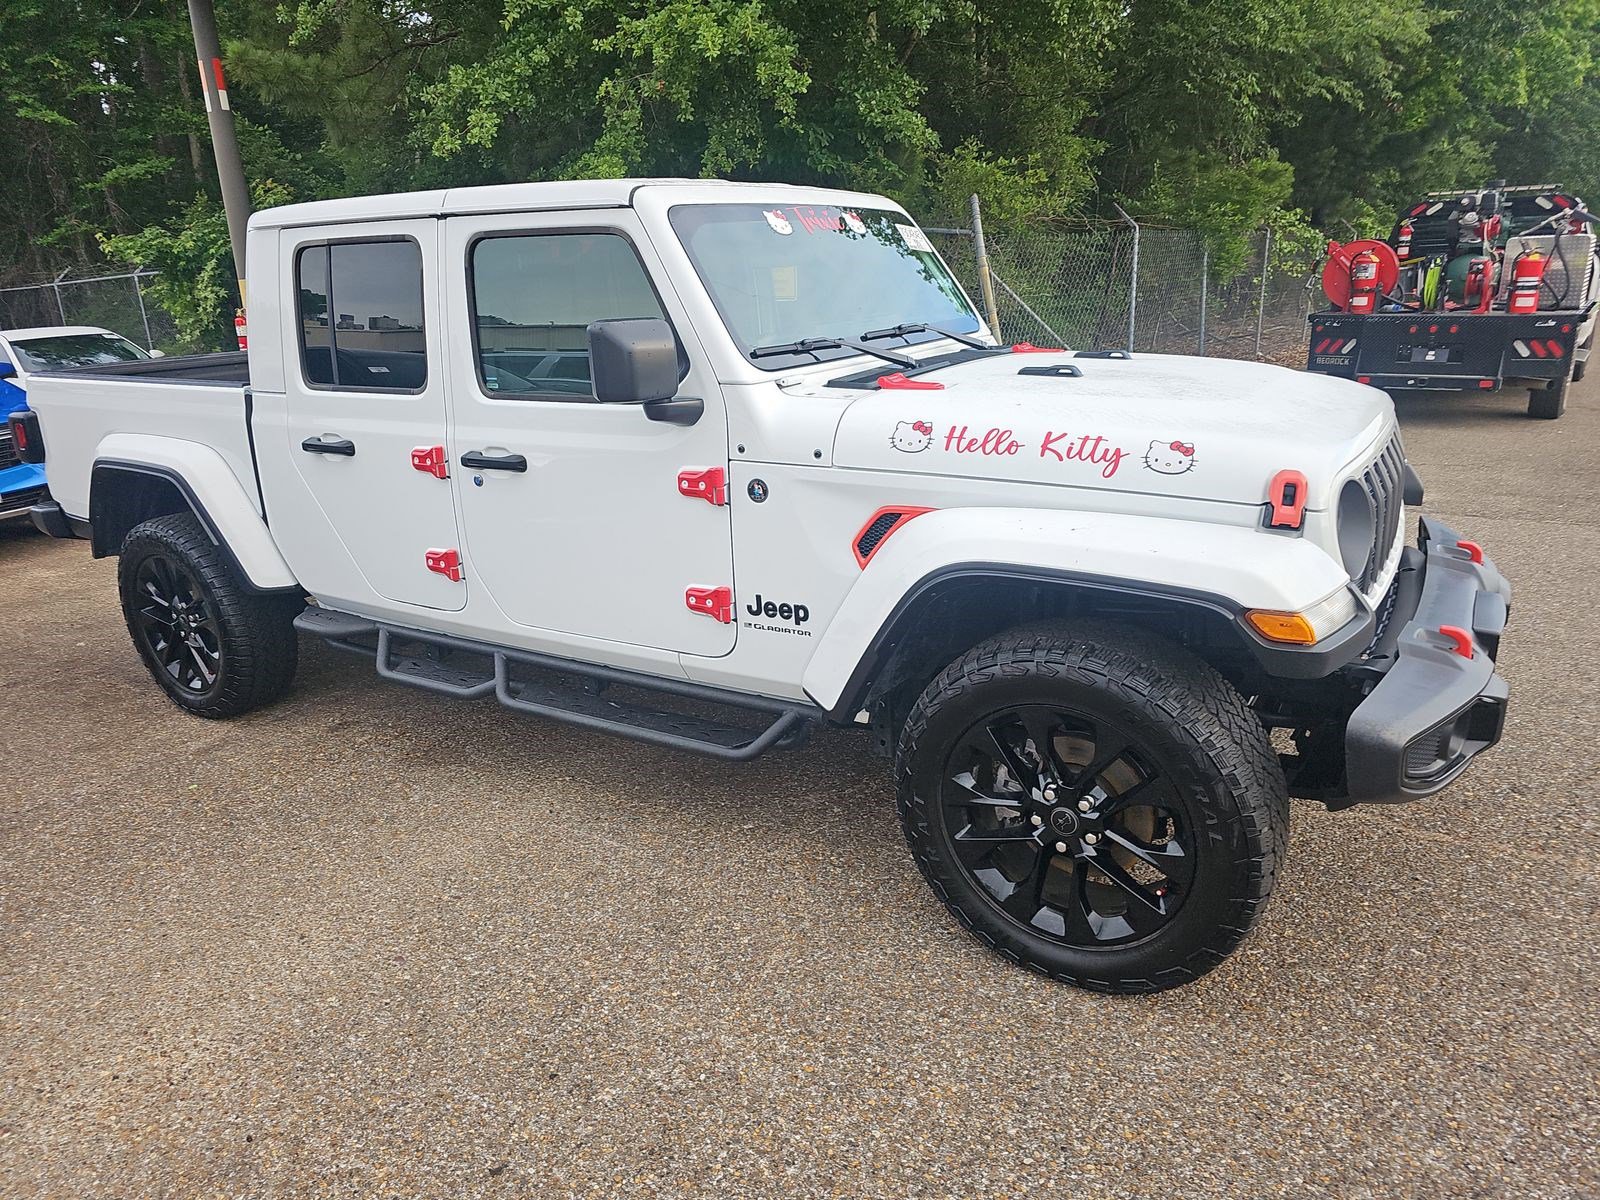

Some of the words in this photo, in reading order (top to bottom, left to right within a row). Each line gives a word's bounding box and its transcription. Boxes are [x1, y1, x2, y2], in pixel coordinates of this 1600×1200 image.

[944, 425, 1026, 456] Hello
[1040, 431, 1131, 479] Kitty
[746, 594, 810, 626] Jeep
[753, 623, 813, 637] GLADIATOR
